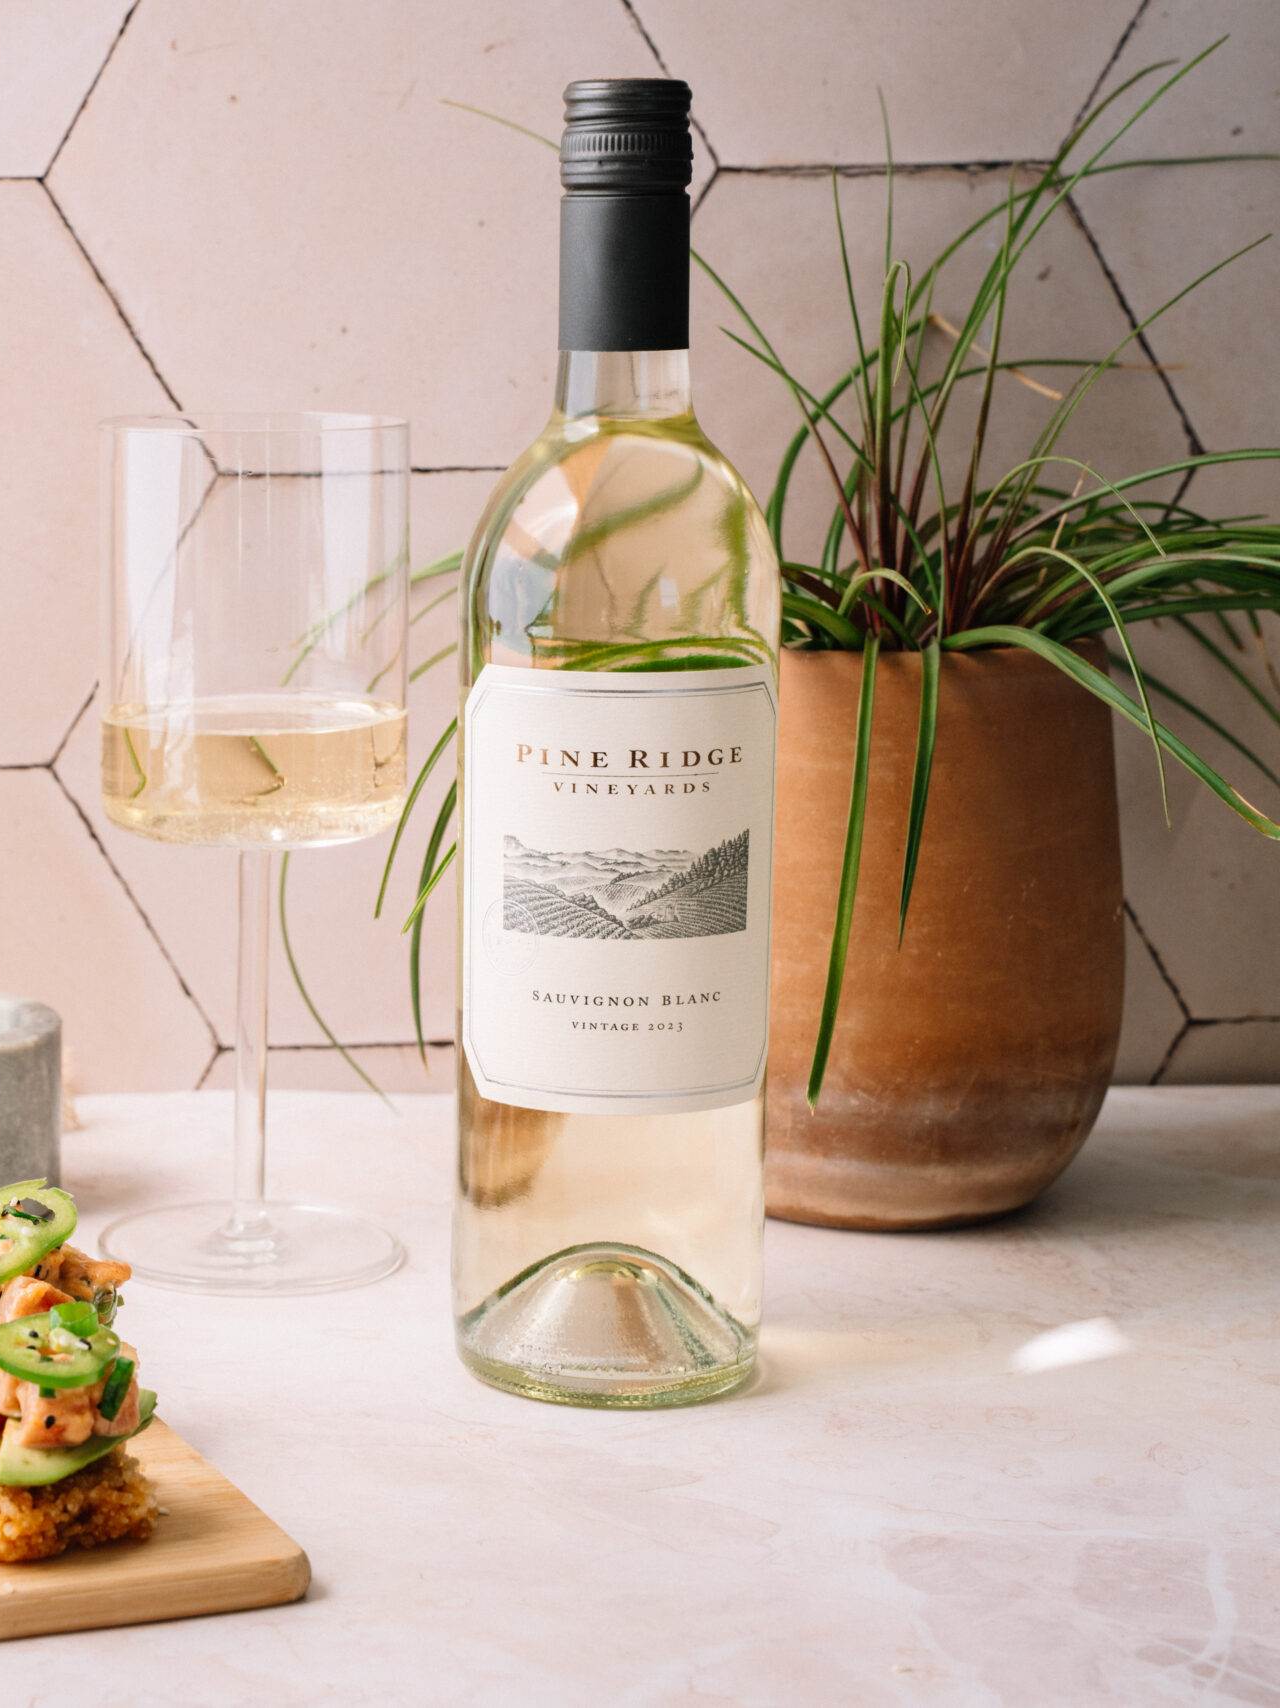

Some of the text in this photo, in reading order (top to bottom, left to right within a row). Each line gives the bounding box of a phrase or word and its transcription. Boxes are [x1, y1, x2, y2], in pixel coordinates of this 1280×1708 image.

[553, 781, 711, 796] VINEYARDS
[532, 990, 721, 1007] SAUVIGNON BLANC
[571, 1021, 684, 1033] VINTAGE 2023
